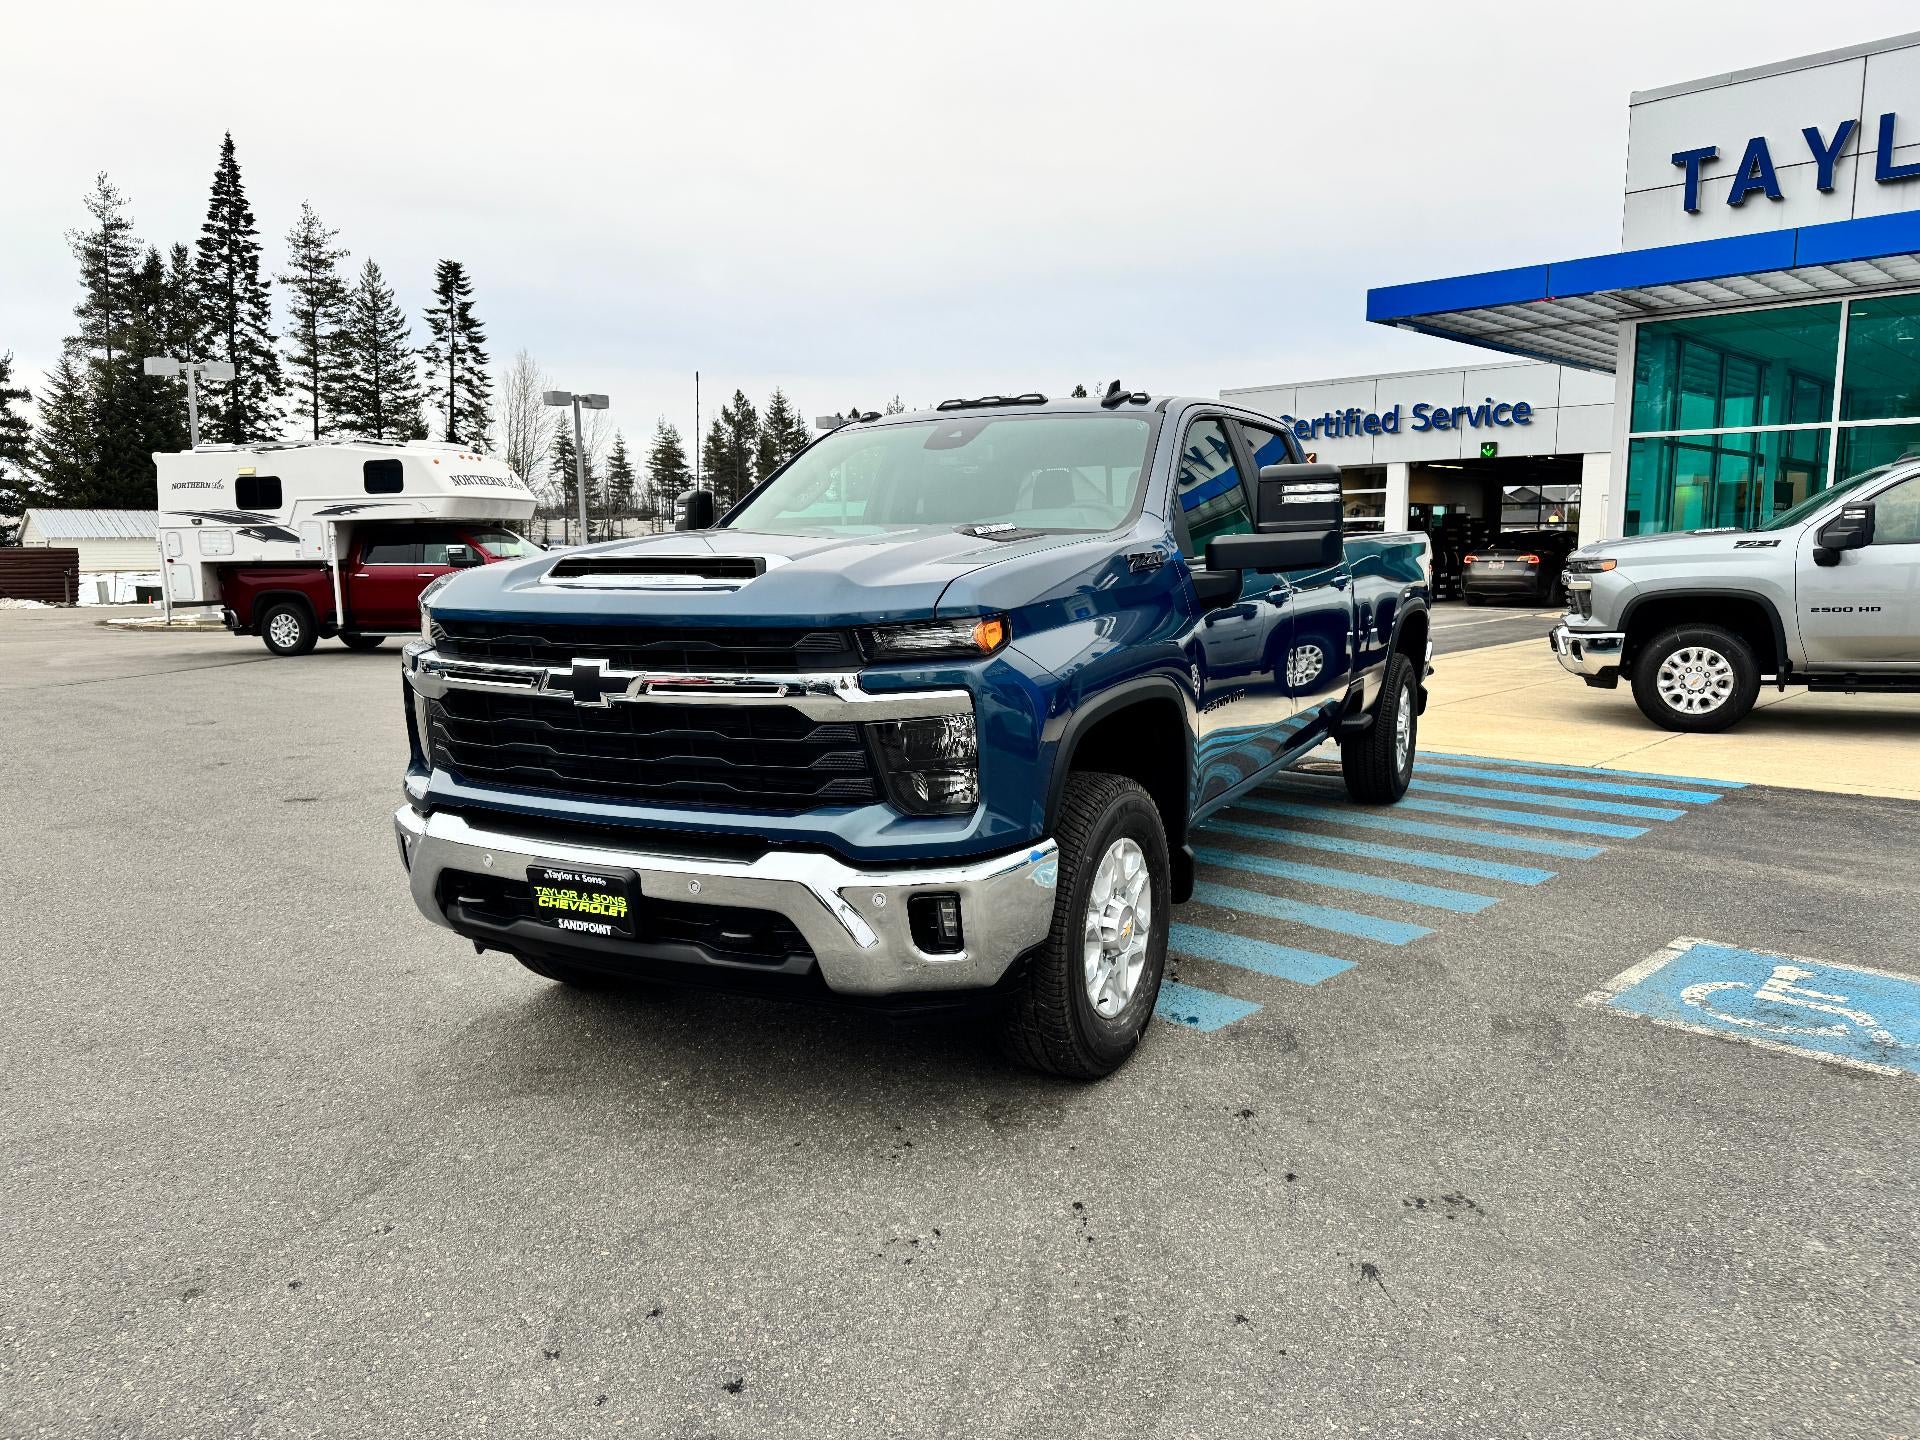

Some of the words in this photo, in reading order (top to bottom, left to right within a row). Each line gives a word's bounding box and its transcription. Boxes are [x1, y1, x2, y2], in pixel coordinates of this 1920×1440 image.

[1671, 112, 1920, 214] TAYL
[1411, 397, 1533, 432] Service
[171, 481, 211, 490] NORTHERN
[449, 474, 507, 487] NORTHERN
[546, 869, 573, 881] Taylor
[533, 886, 578, 900] TAYLOR
[581, 892, 590, 902] &
[592, 893, 627, 907] SONS
[538, 896, 628, 918] CHEVROLET
[558, 918, 612, 936] SANDPOINT
